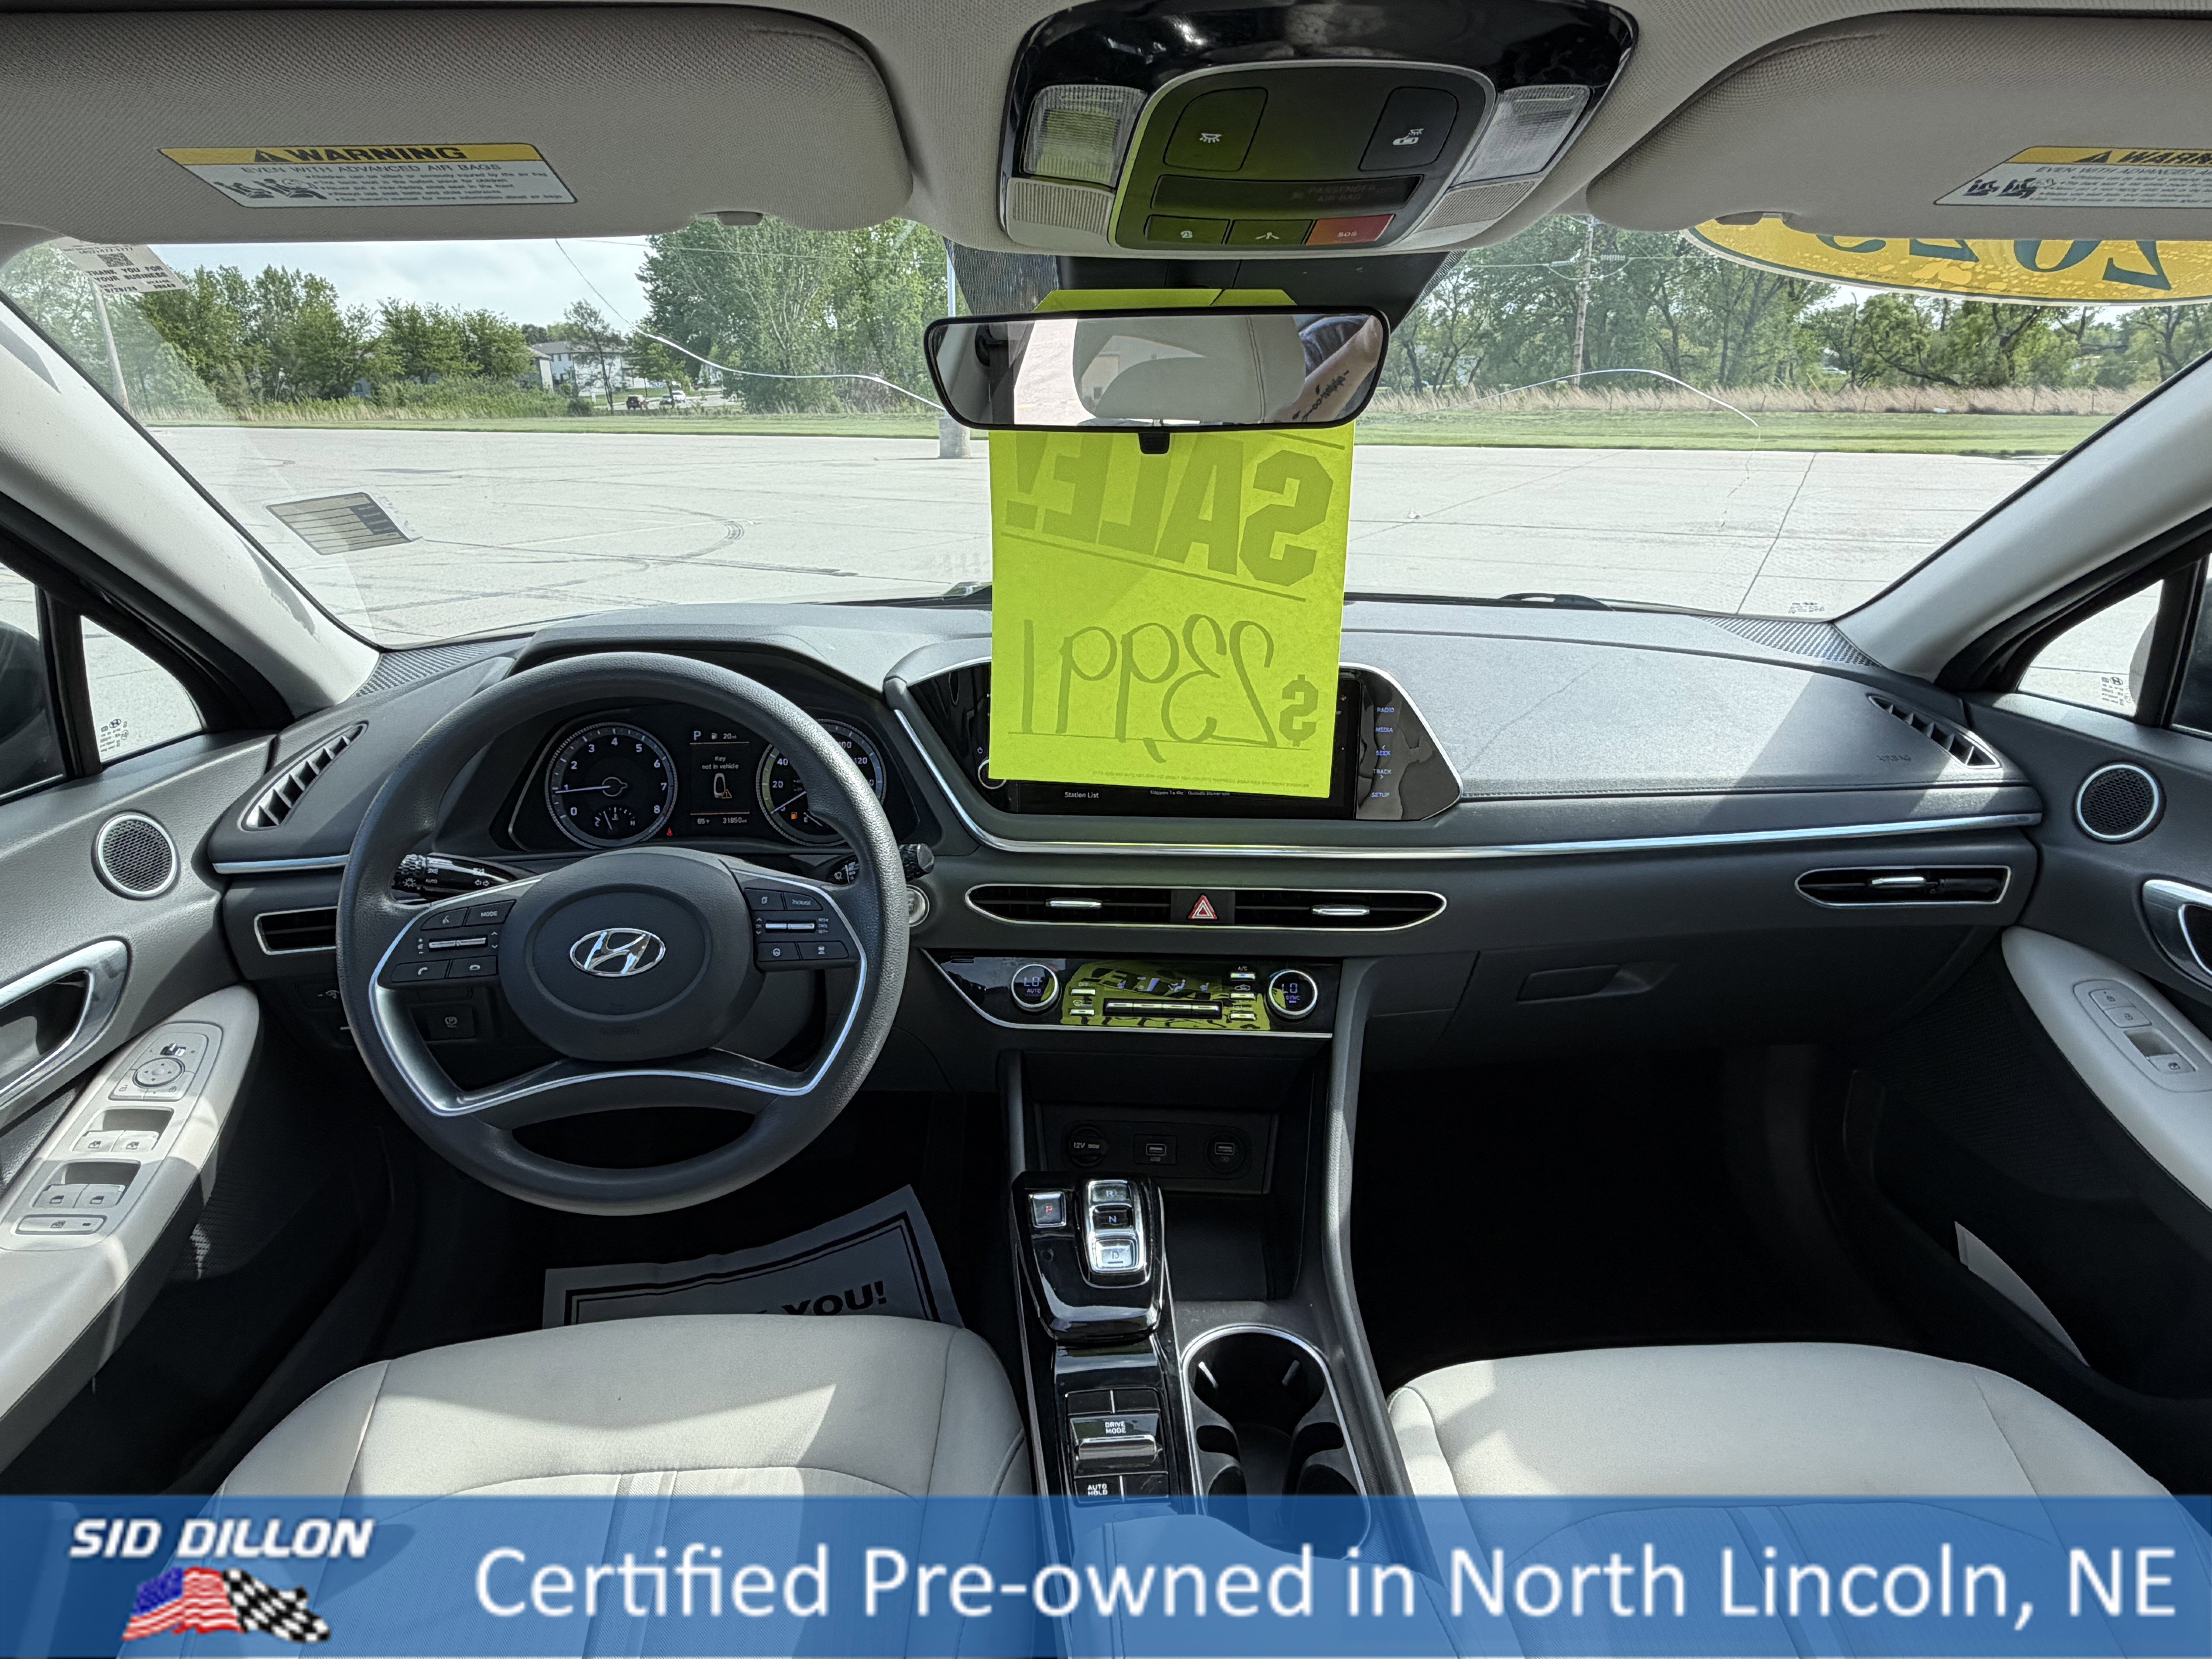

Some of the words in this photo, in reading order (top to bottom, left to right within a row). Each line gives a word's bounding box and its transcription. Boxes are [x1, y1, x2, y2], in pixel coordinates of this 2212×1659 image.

[284, 148, 467, 161] WARNING
[123, 272, 168, 280] BUSINESS
[693, 730, 701, 740] P
[611, 737, 618, 746] 4
[588, 744, 595, 753] 3
[636, 744, 642, 752] 5
[571, 761, 577, 769] 2
[654, 760, 661, 768] 6
[777, 758, 788, 766] 40
[661, 783, 667, 791] 7
[570, 807, 577, 816] 0
[653, 805, 661, 814] 8
[1281, 983, 1298, 994] LO
[1046, 1206, 1054, 1214] P
[1108, 1215, 1117, 1224] N
[1111, 1251, 1120, 1259] D
